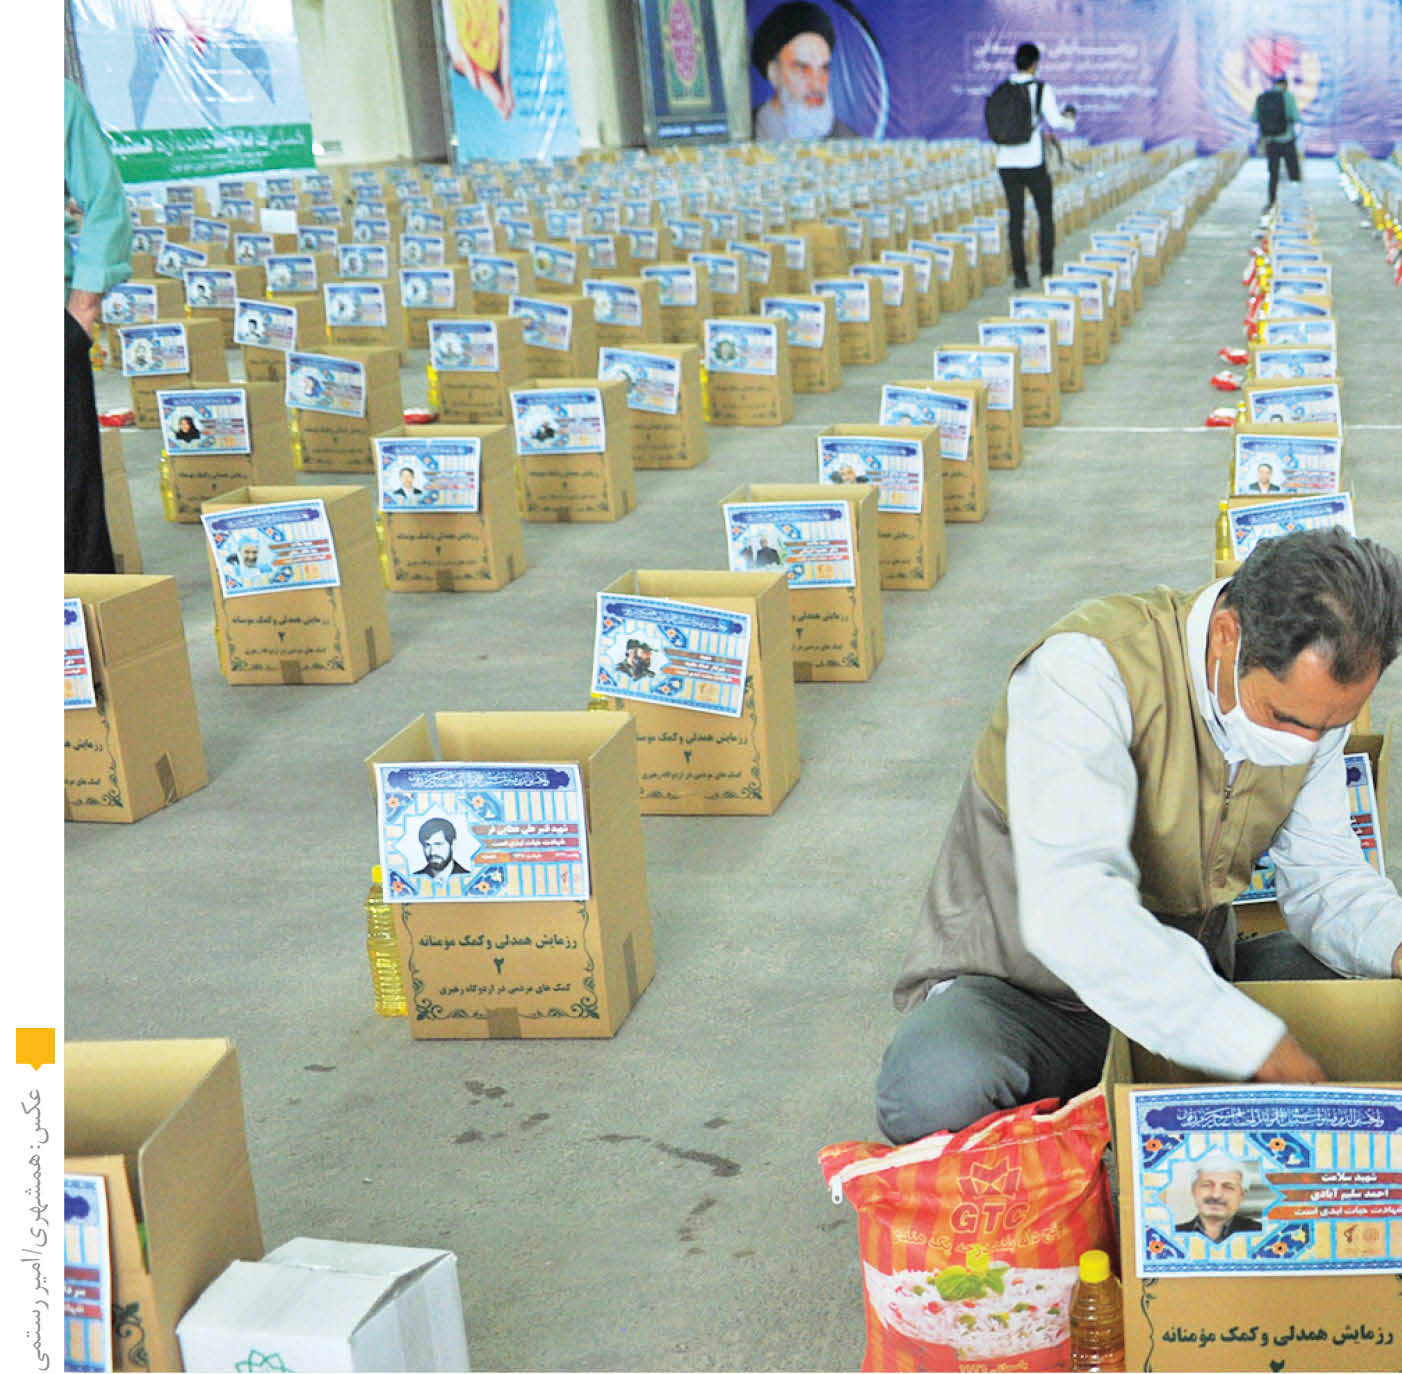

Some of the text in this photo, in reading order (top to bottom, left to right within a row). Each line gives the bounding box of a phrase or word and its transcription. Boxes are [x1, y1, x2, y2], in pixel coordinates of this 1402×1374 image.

[495, 933, 532, 950] همدلی
[535, 932, 578, 950] رزمایش
[493, 956, 505, 976] ۲
[1320, 1172, 1378, 1183] شهید سلامت
[1364, 1189, 1389, 1199] احمد
[950, 1202, 1030, 1234] GTC
[1294, 1206, 1319, 1217] است
[1319, 1206, 1343, 1218] ابدی
[1343, 1206, 1369, 1215] حیات
[1273, 1325, 1328, 1347] همدلی
[1332, 1323, 1394, 1346] رزمایش
